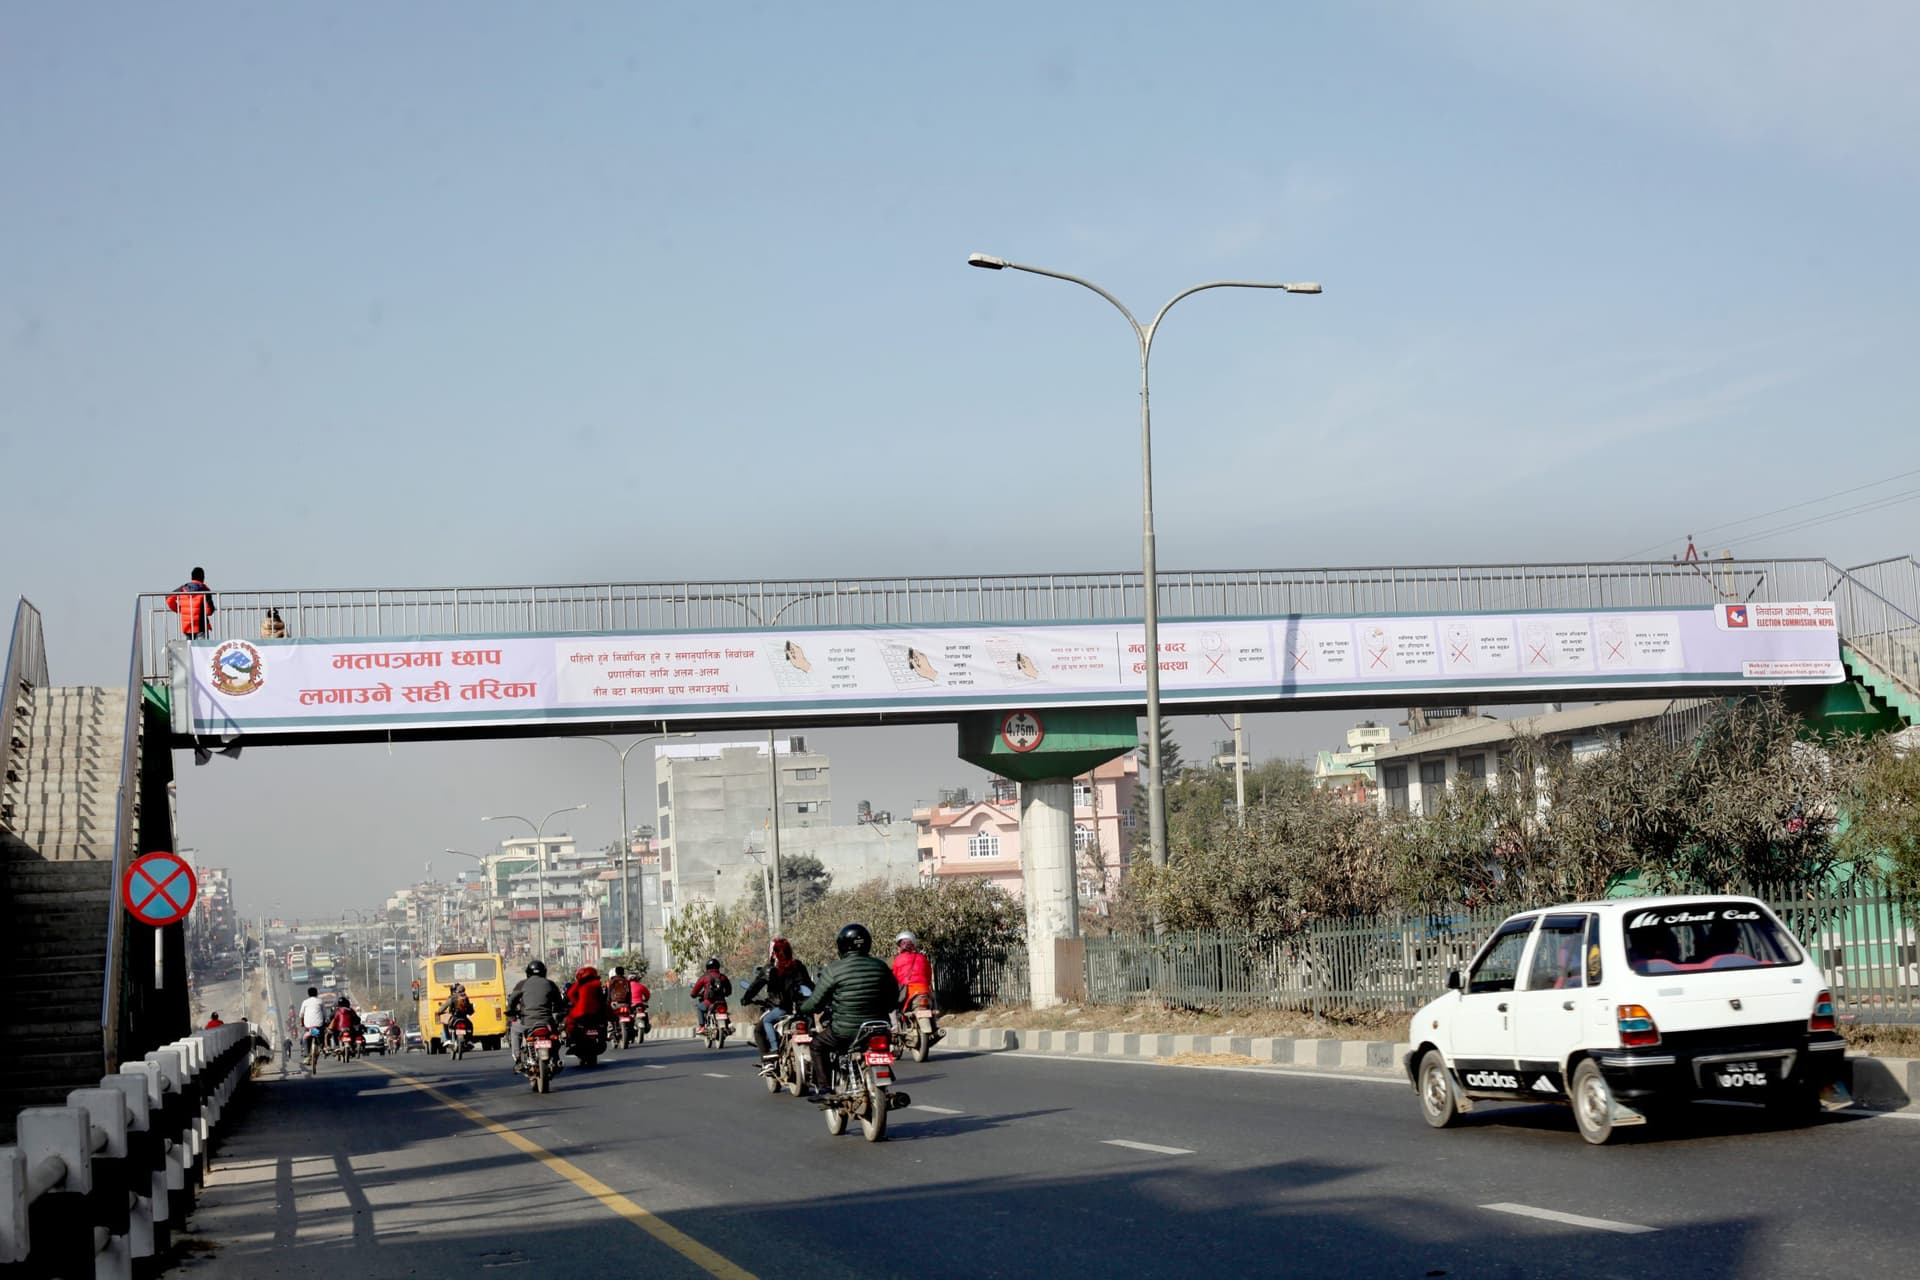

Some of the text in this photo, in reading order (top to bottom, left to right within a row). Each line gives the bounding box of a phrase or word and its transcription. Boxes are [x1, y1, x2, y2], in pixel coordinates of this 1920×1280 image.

[1813, 604, 1833, 616] नेपाल
[1757, 618, 1781, 627] ELECTION
[1819, 618, 1834, 627] NEPAL
[1165, 642, 1187, 652] बदर
[332, 649, 503, 670] मतपत्रमा छाप
[664, 652, 671, 661] र
[299, 679, 536, 706] लगाउने सही तरिका
[1721, 910, 1760, 920] Cab
[1466, 1071, 1519, 1088] adidas
